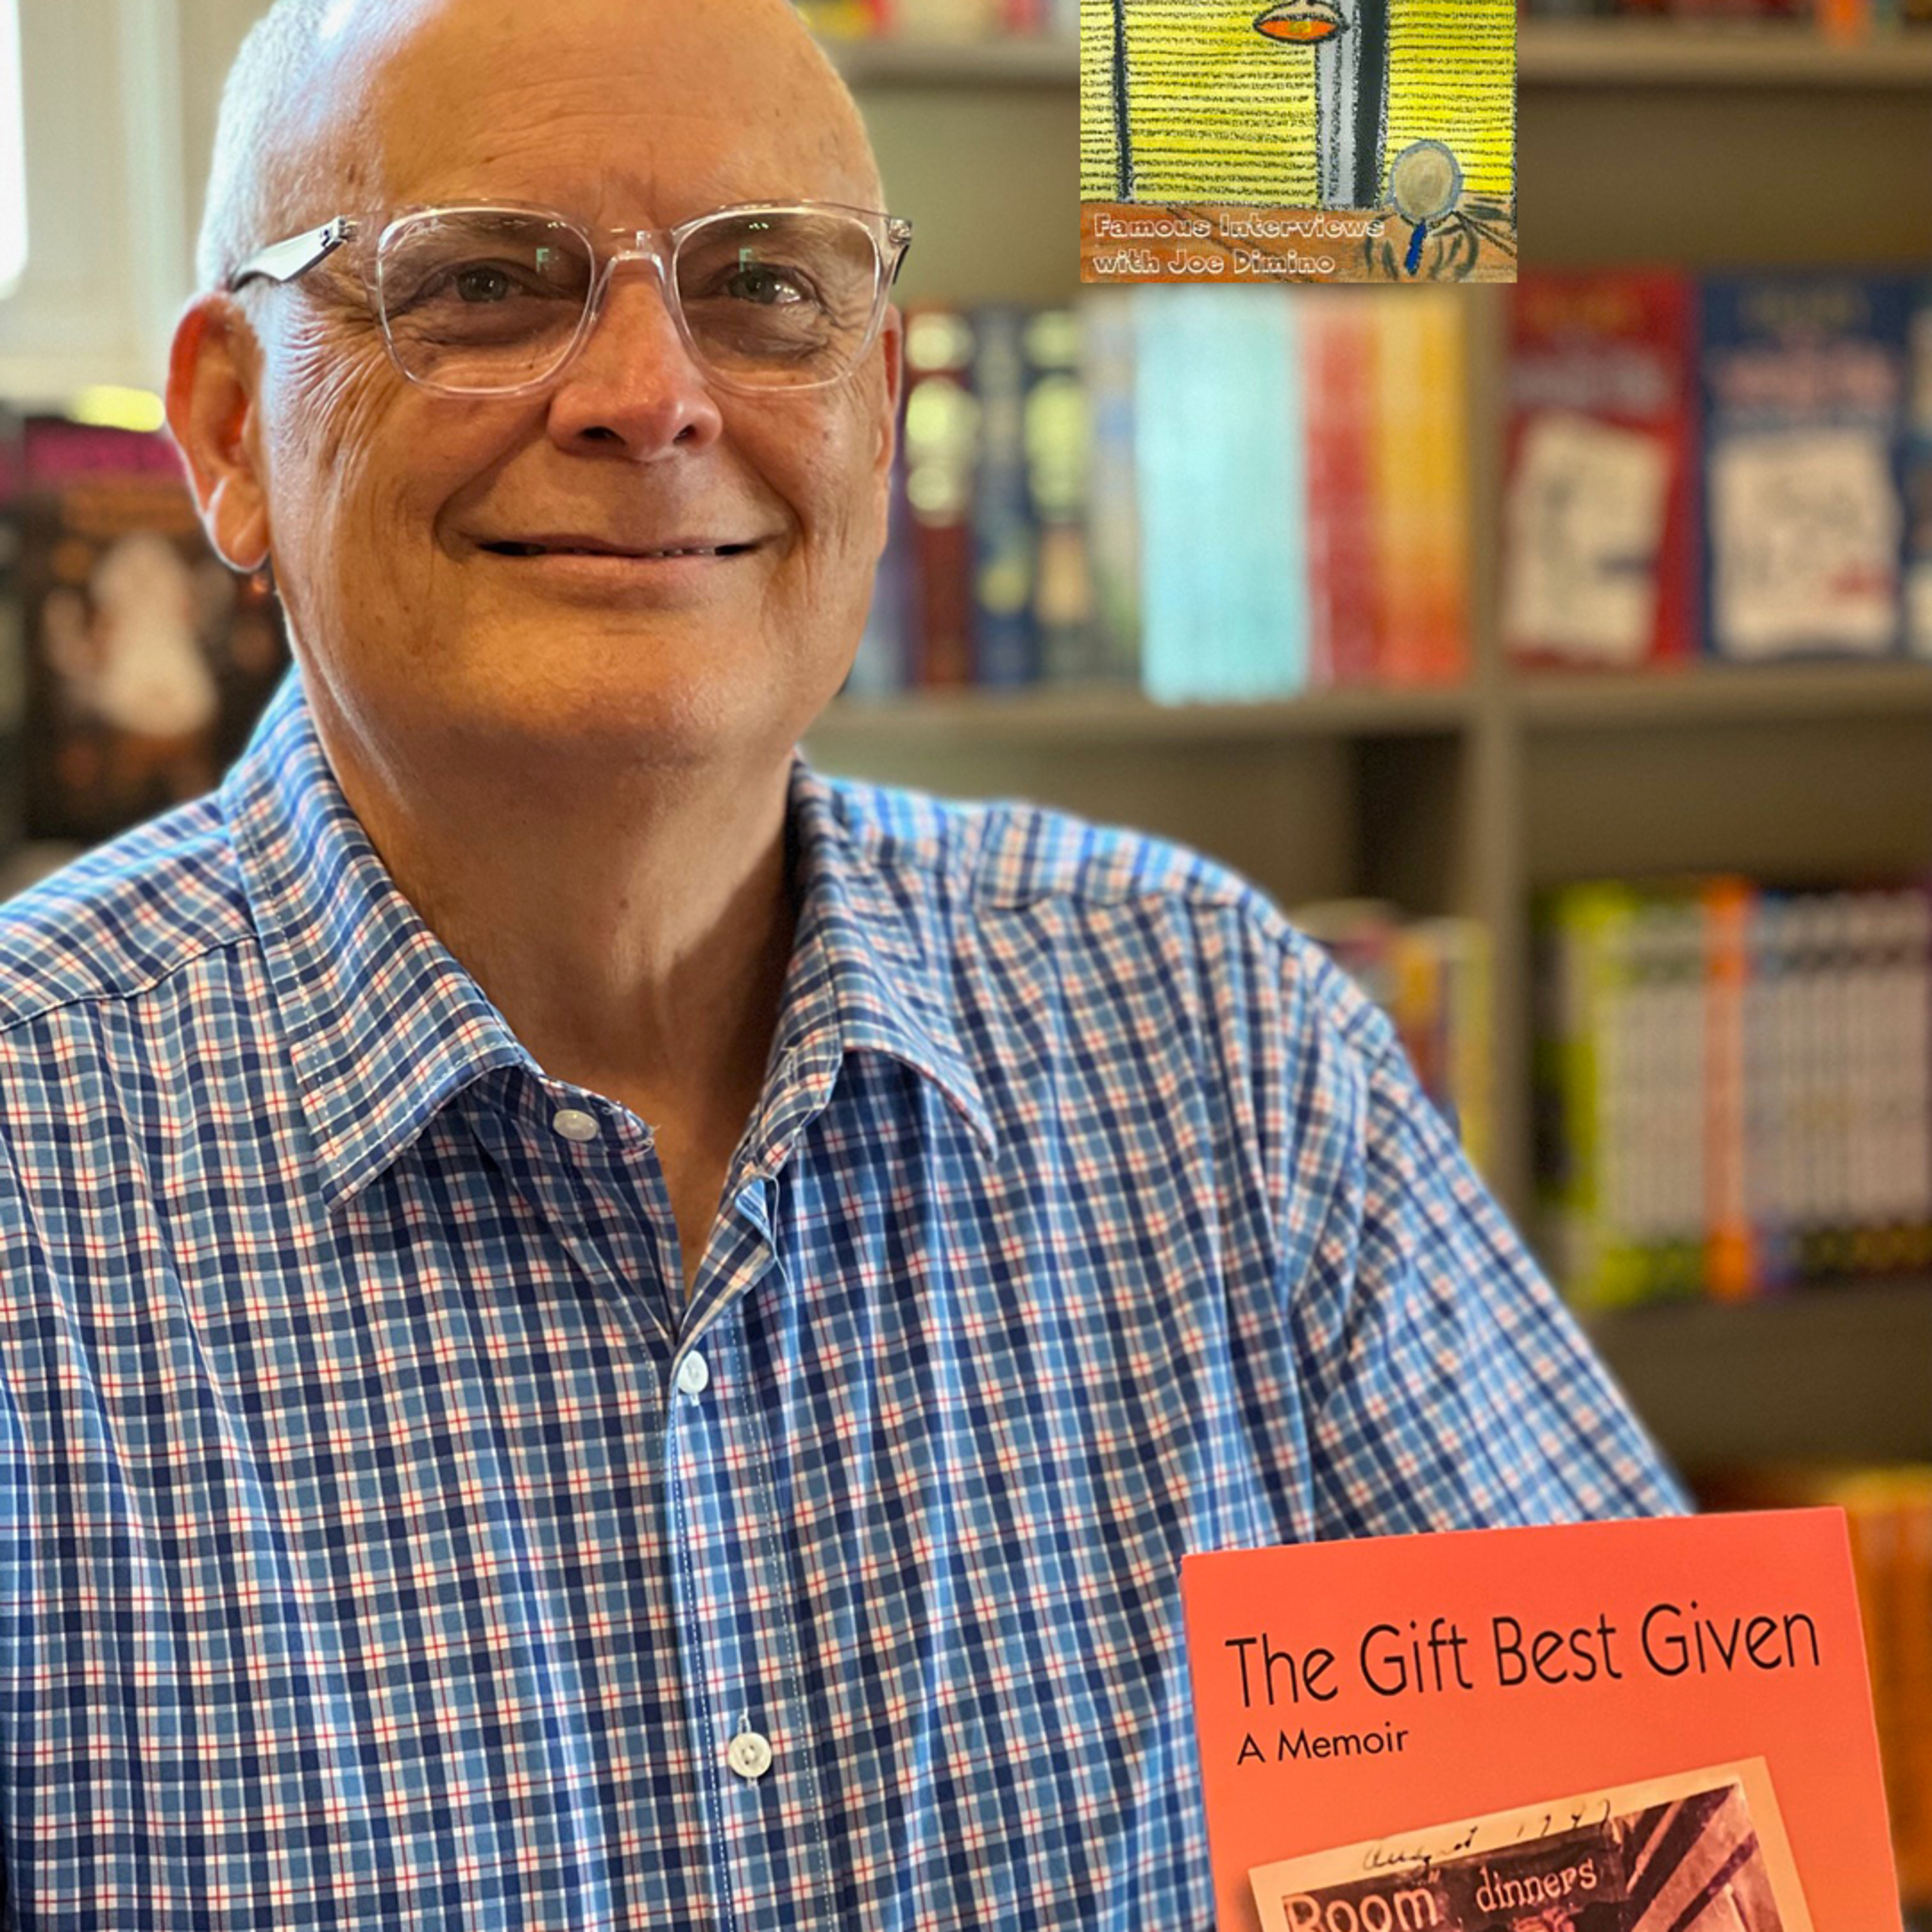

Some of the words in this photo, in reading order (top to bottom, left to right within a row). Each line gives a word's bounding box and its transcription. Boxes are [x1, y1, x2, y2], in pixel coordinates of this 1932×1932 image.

[1225, 1633, 1338, 1707] The
[1360, 1617, 1473, 1696] Gift
[1492, 1613, 1622, 1686] Best
[1642, 1600, 1820, 1676] Given
[1237, 1732, 1265, 1765] A
[1278, 1721, 1409, 1761] Memoir
[1476, 1859, 1598, 1913] dinners
